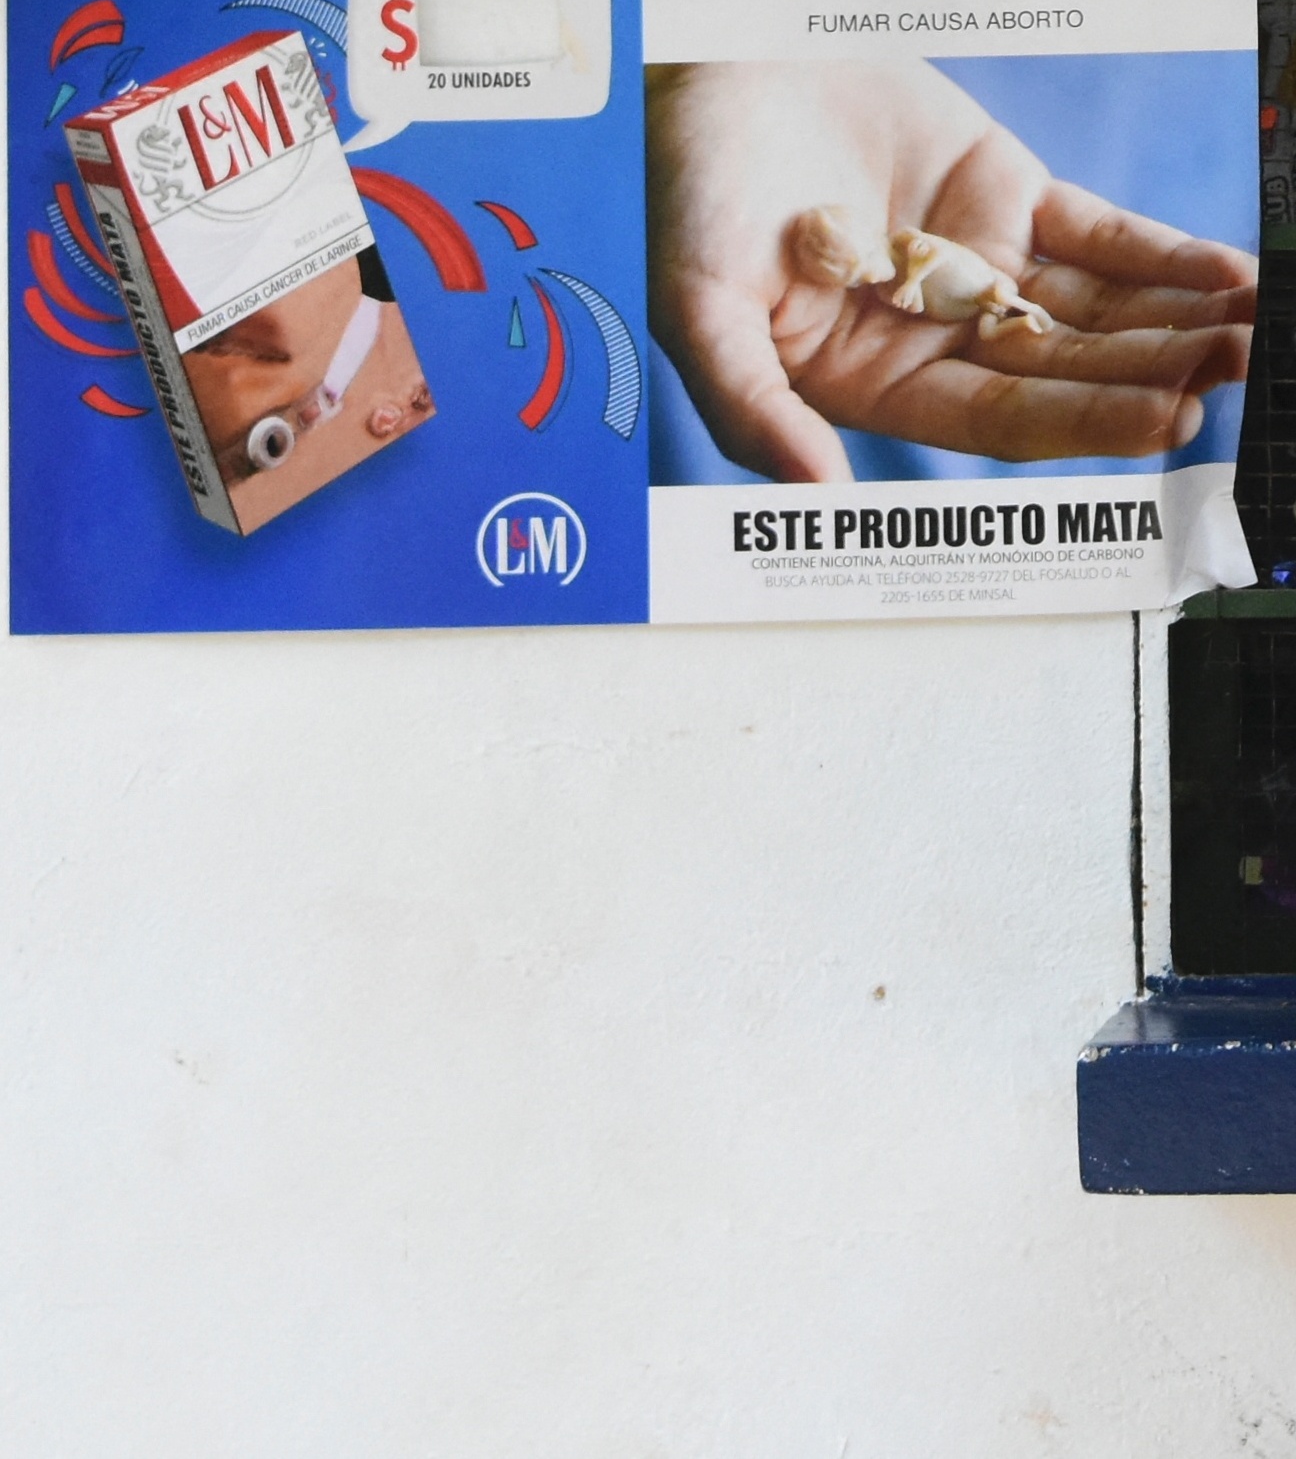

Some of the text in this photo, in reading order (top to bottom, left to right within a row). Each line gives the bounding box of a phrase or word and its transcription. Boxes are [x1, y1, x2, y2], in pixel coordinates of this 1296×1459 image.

[808, 9, 1085, 34] FUMAR CAUSA ABORTO
[427, 71, 532, 90] 20 UNIDADES
[178, 64, 295, 192] L&M
[187, 234, 364, 342] FUMAR CAUSA CÁNCER DE LARINGE
[99, 211, 208, 497] ESTE PRODUCTO MATA
[733, 500, 1163, 552] ESTE PRODUCTO MATA
[496, 516, 567, 575] L&M
[752, 547, 1144, 570] CONTIENE NICOTINA, ALQUITRÁN Y MONÓXIDO DE CARBONO
[765, 574, 807, 588] BUSCA
[811, 573, 854, 586] AYUDA
[857, 573, 873, 585] AL
[1012, 568, 1035, 582] DEL
[1039, 567, 1099, 581] FOSALUD
[1101, 567, 1112, 579] O
[1116, 566, 1132, 578] AL
[949, 589, 966, 602] DE
[969, 587, 1016, 602] MINSAL
